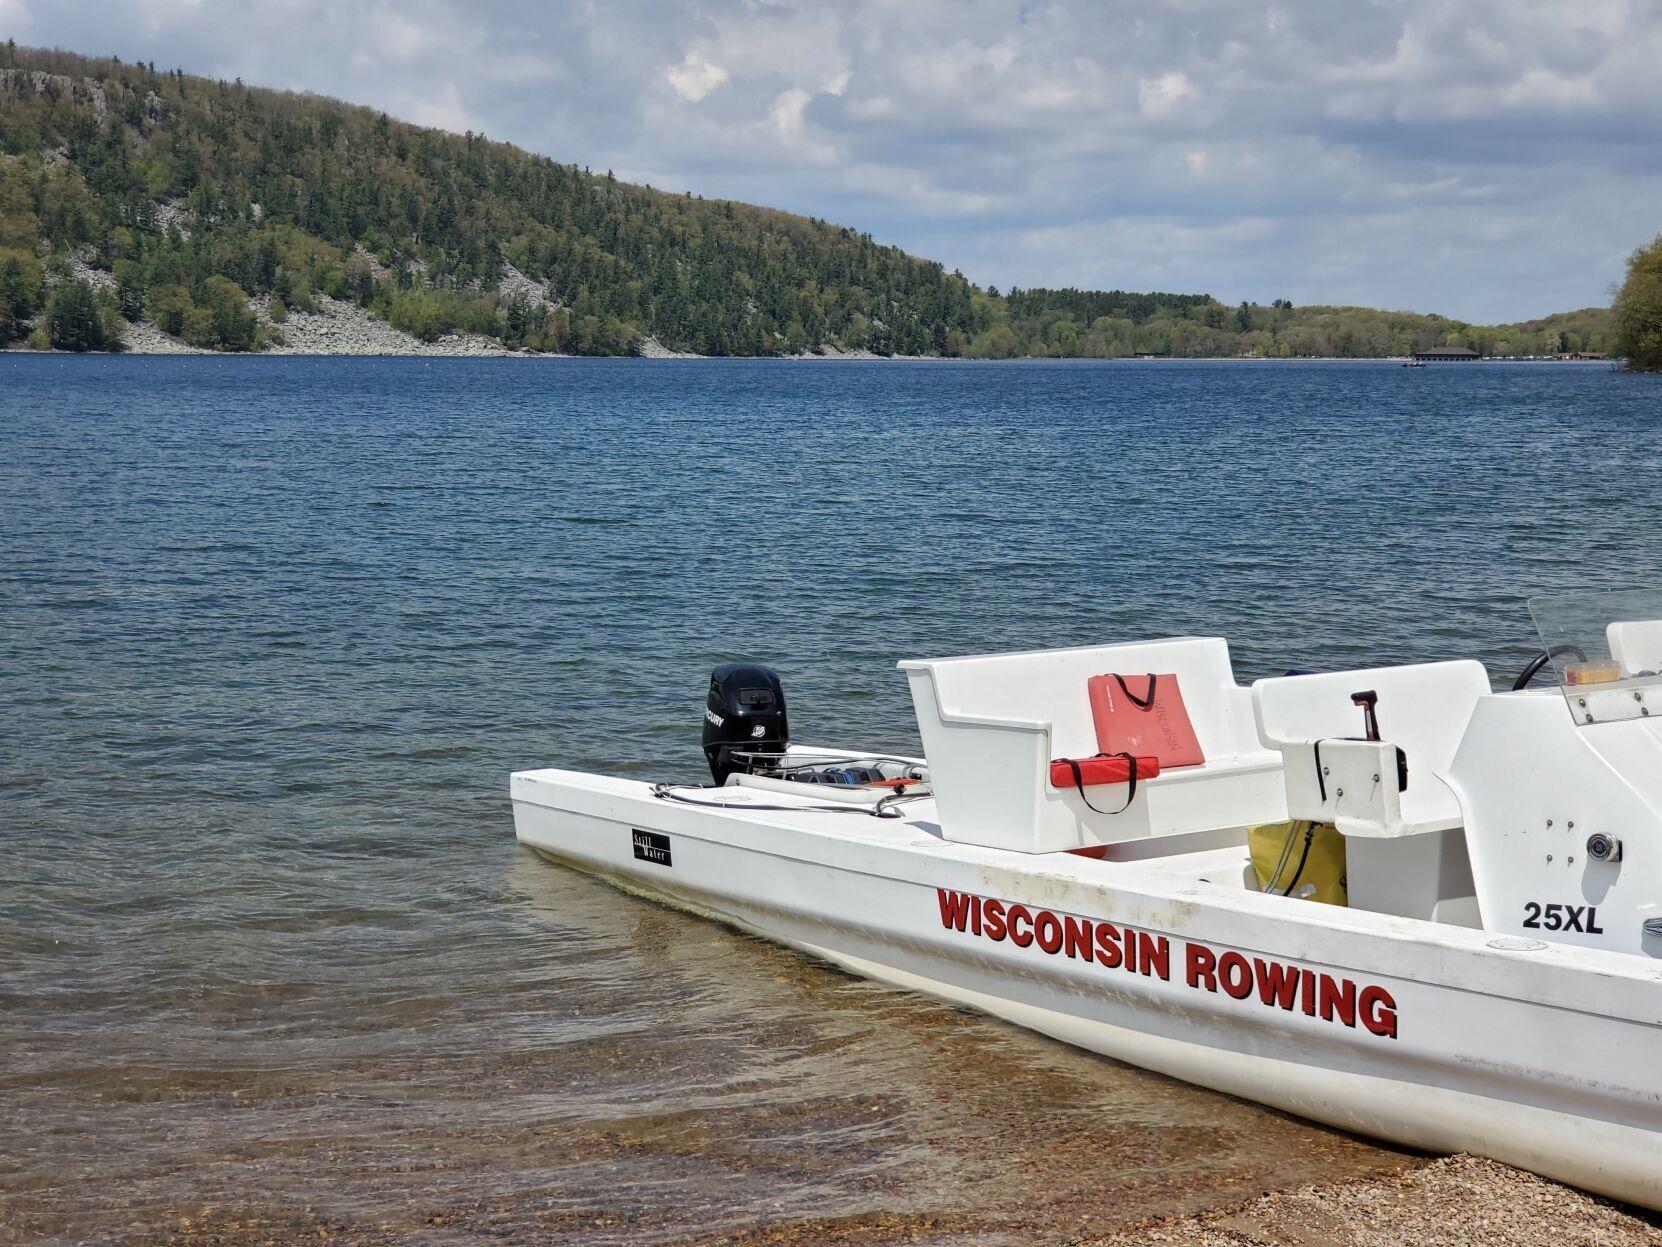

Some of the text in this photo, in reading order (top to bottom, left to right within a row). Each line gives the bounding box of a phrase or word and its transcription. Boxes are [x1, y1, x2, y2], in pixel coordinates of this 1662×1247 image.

[705, 709, 725, 728] CURY
[633, 833, 652, 847] Still
[643, 846, 665, 861] Water
[1522, 901, 1604, 935] 25XL
[936, 887, 1398, 1039] WISCONSIN ROWING
